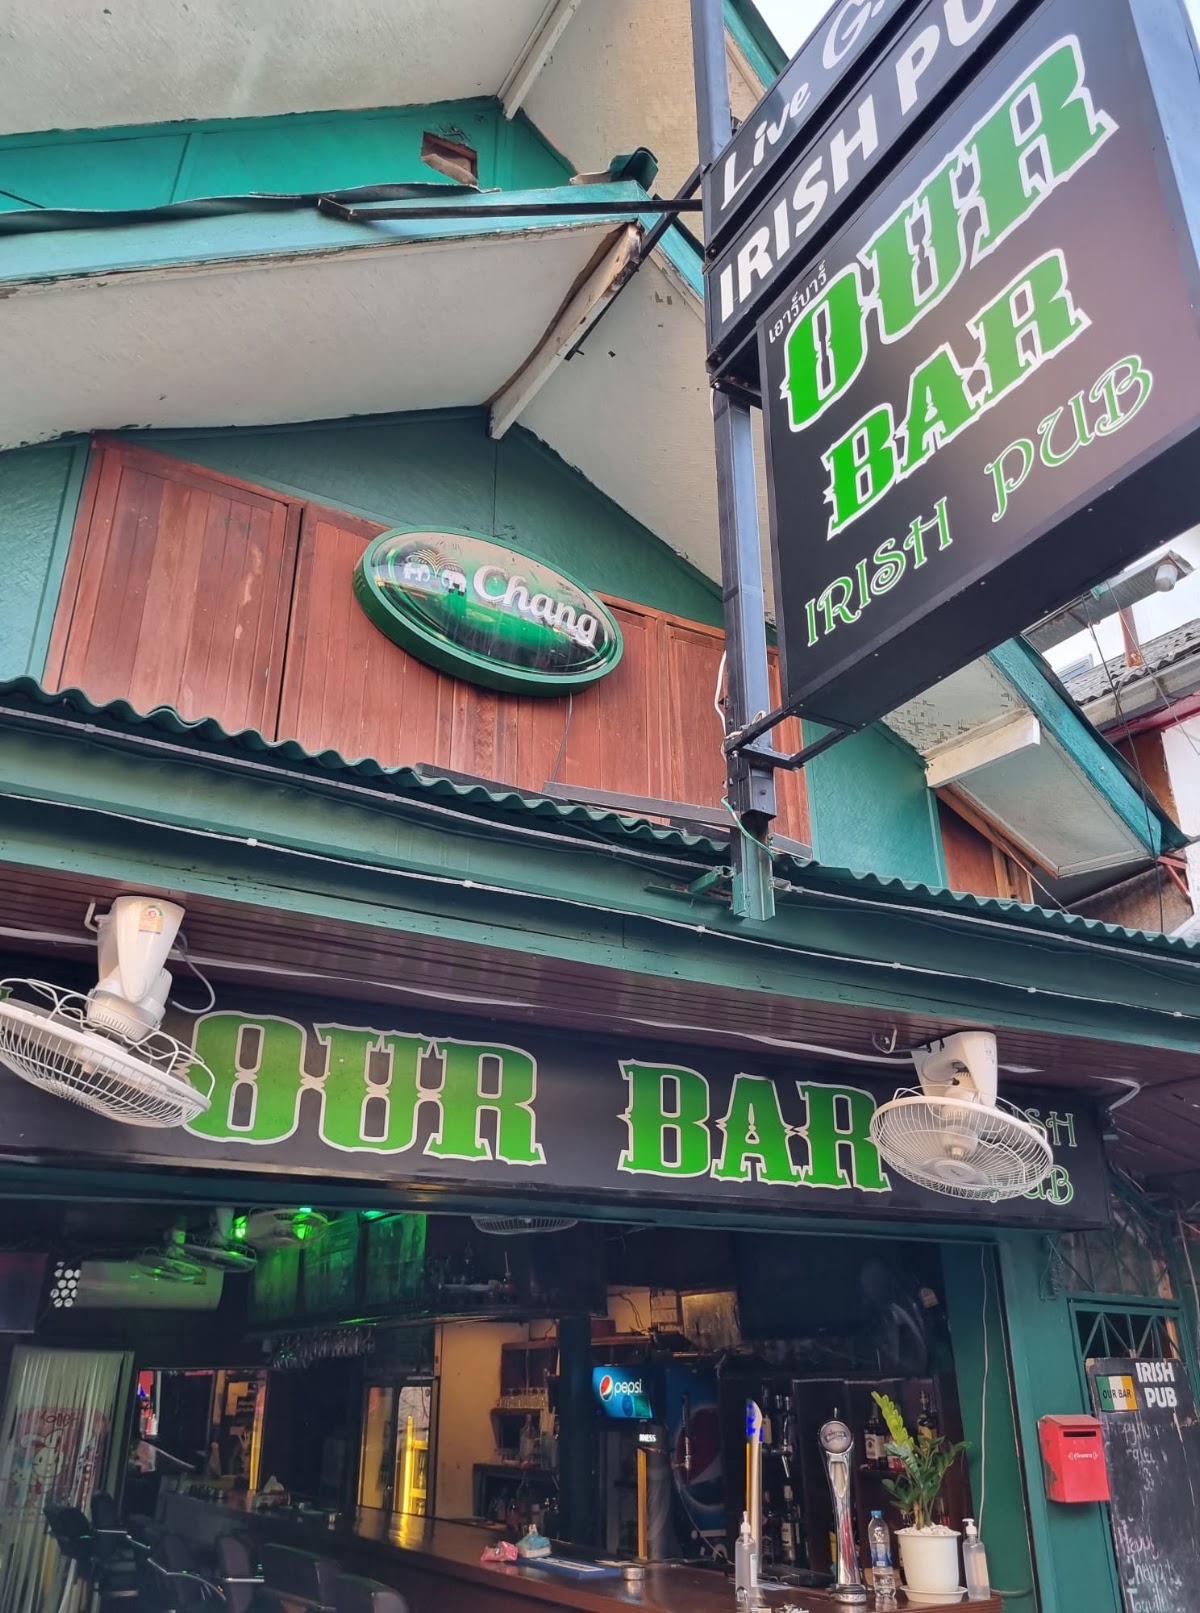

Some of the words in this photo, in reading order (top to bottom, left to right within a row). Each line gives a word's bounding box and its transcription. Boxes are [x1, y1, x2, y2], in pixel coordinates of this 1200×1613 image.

[720, 83, 811, 211] Live
[720, 94, 879, 324] IRISH
[780, 34, 1120, 433] OUR
[820, 248, 1093, 541] BAR
[805, 497, 953, 647] IRISH
[983, 354, 1153, 522] PUB
[473, 564, 599, 650] Chang
[174, 1010, 547, 1166] OUR
[617, 1059, 892, 1193] BAR
[614, 1378, 643, 1396] pepsi
[1102, 1389, 1117, 1399] OUR
[1118, 1389, 1131, 1399] BAR
[1135, 1362, 1176, 1382] IRISH
[1144, 1386, 1178, 1408] PUB
